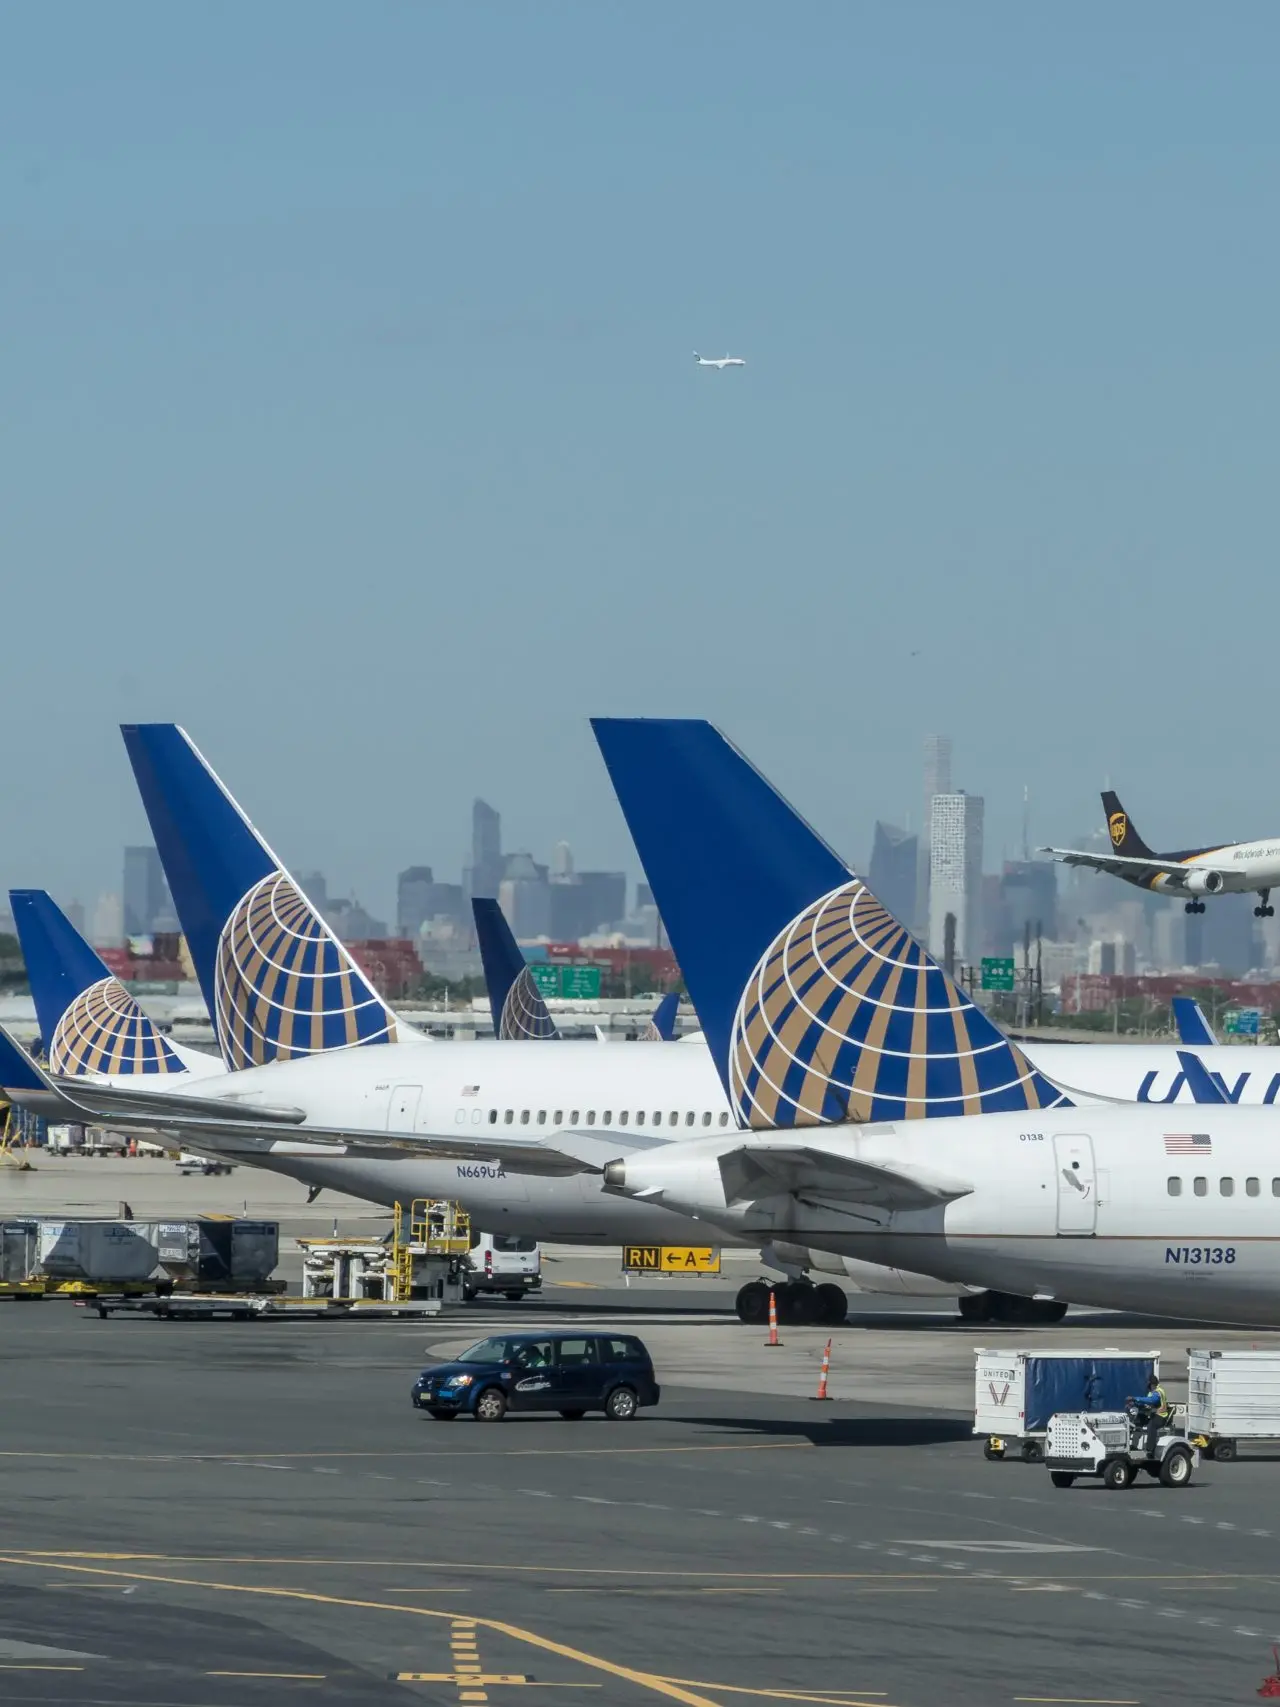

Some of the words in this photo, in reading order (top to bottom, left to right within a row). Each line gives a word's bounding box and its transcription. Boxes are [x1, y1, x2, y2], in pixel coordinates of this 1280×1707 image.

[1233, 848, 1264, 861] Worldwide
[1019, 1133, 1044, 1141] 0138
[630, 1249, 655, 1266] RN
[685, 1251, 697, 1267] A
[1165, 1247, 1236, 1264] N13138
[983, 1370, 1009, 1379] UNITED
